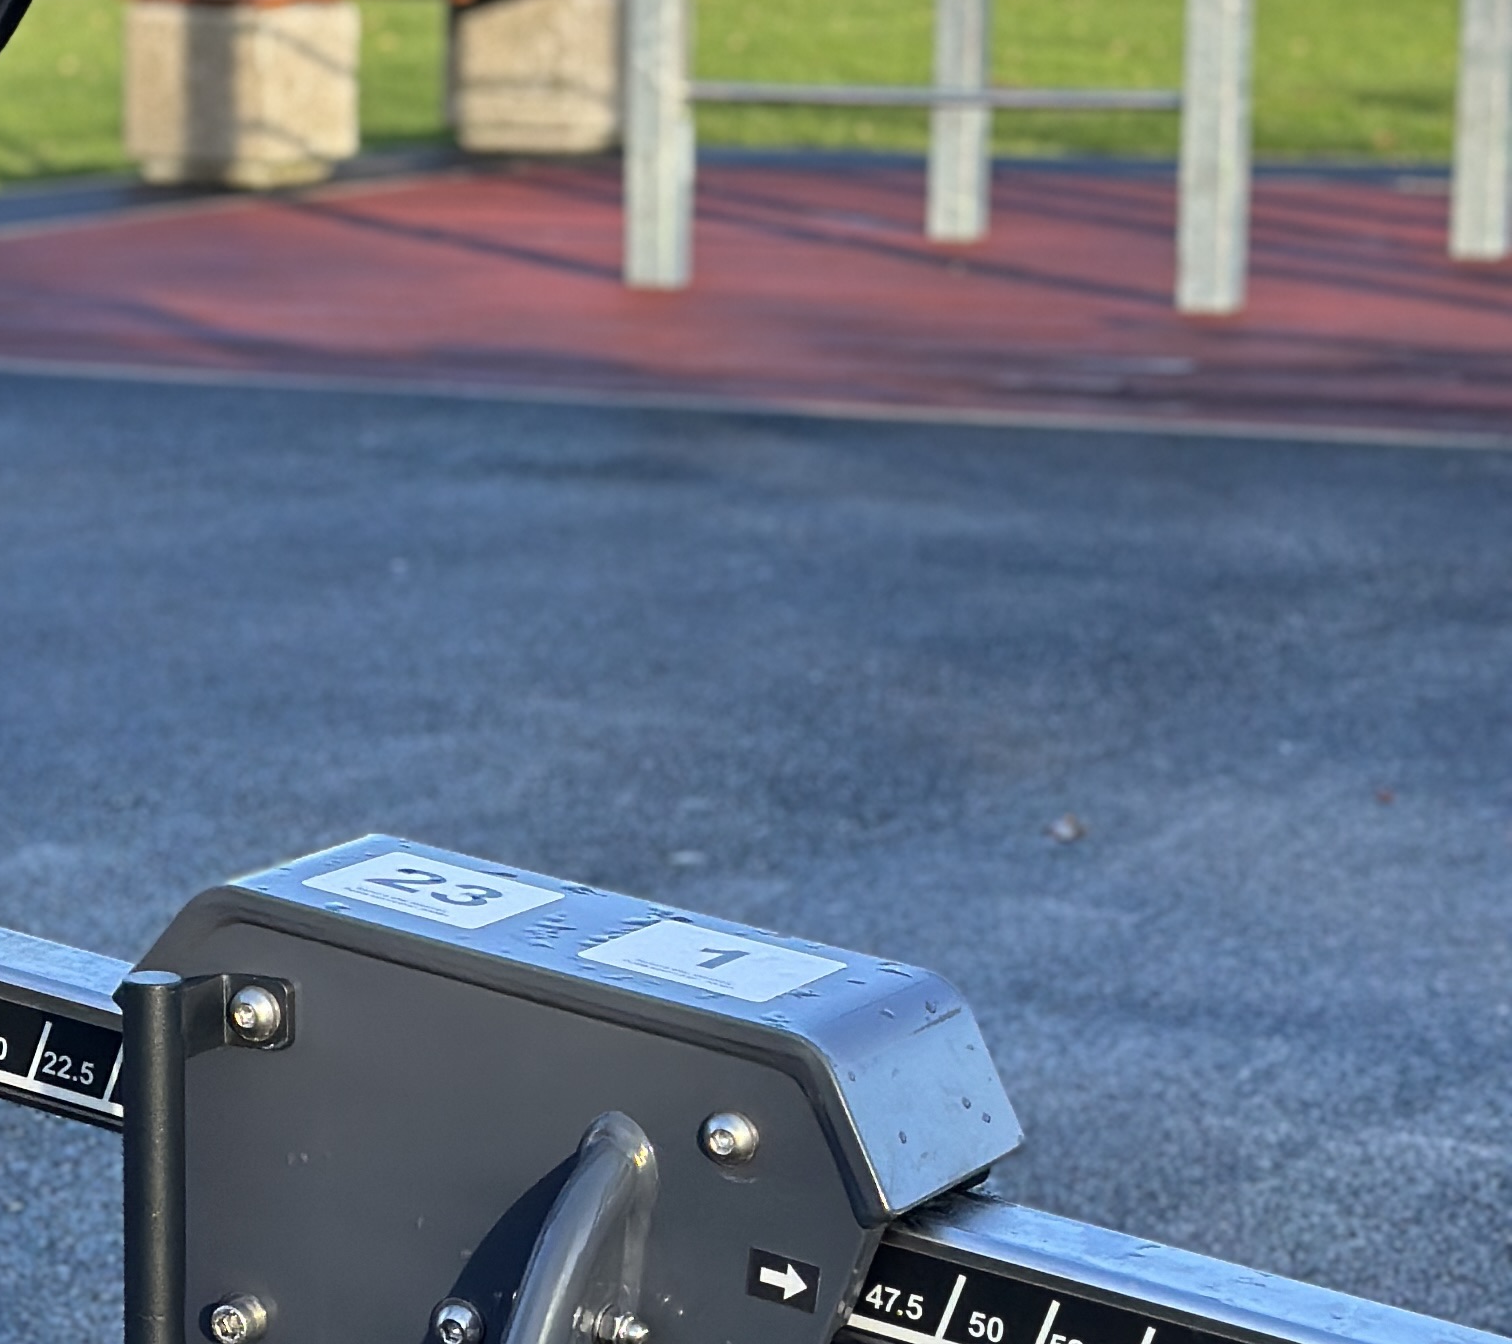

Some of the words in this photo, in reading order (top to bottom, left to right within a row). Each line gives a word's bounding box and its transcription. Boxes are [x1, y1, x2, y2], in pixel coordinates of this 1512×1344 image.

[364, 867, 504, 907] 23
[696, 947, 751, 970] 1
[41, 1051, 95, 1086] 22.5
[865, 1284, 924, 1321] 47.5
[967, 1310, 1004, 1343] 50
